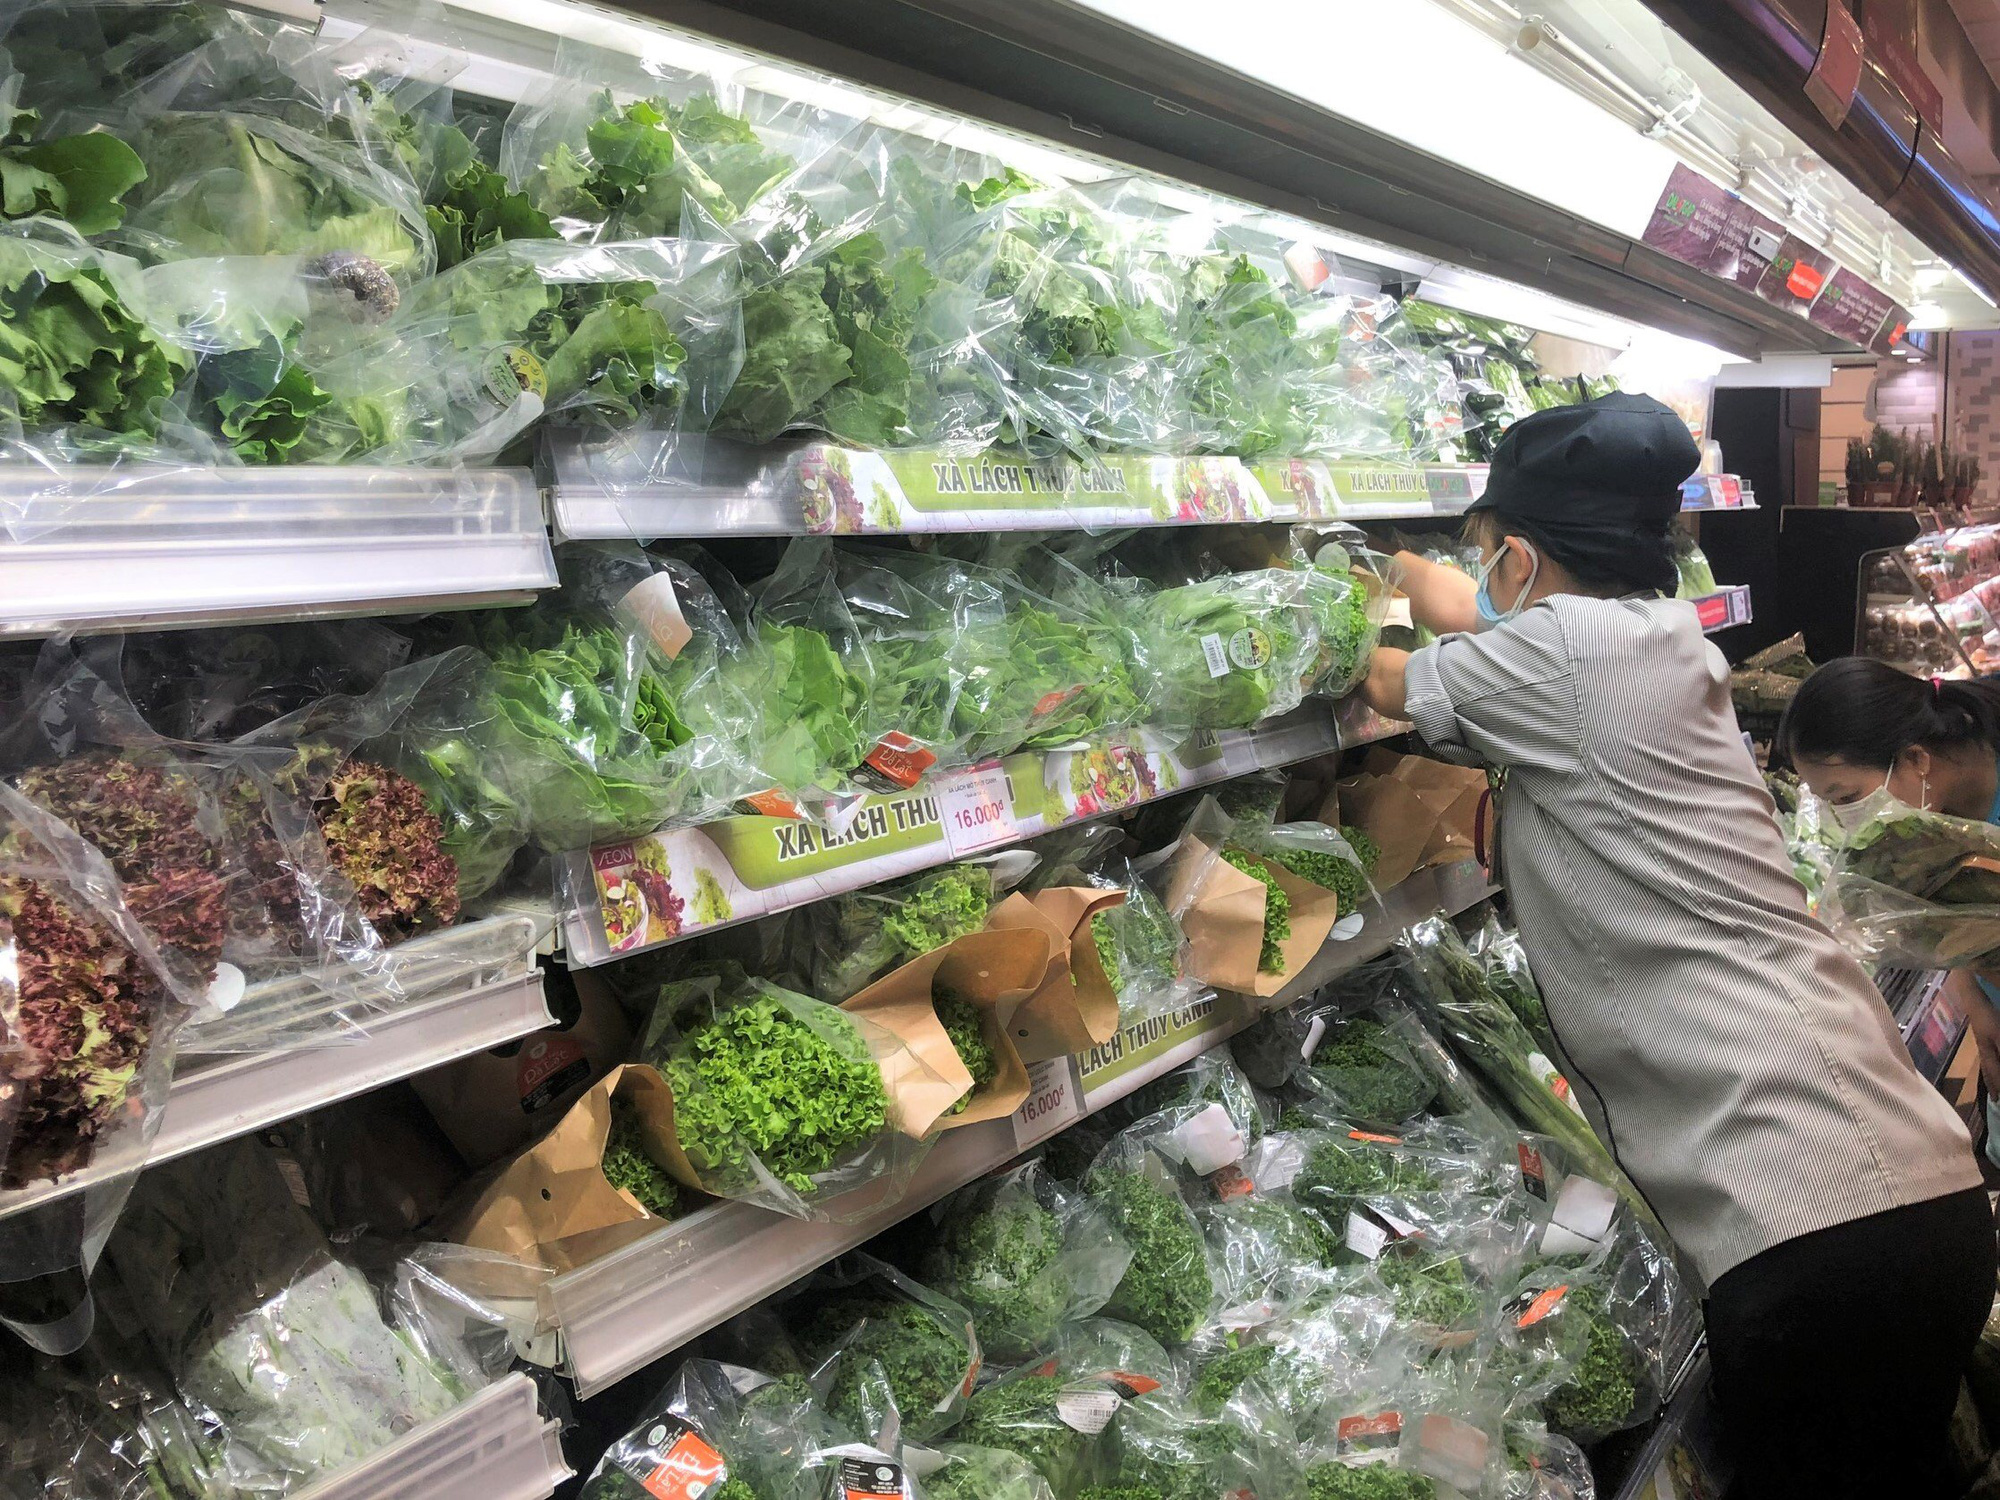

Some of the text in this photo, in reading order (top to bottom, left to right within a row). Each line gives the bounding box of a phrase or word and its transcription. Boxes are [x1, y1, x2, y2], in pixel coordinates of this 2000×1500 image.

[932, 458, 967, 492] XÀ
[968, 458, 1023, 492] LÁCH
[889, 797, 940, 831] THU
[955, 799, 1005, 830] 16.000đ
[1020, 1083, 1065, 1124] 16.000đ
